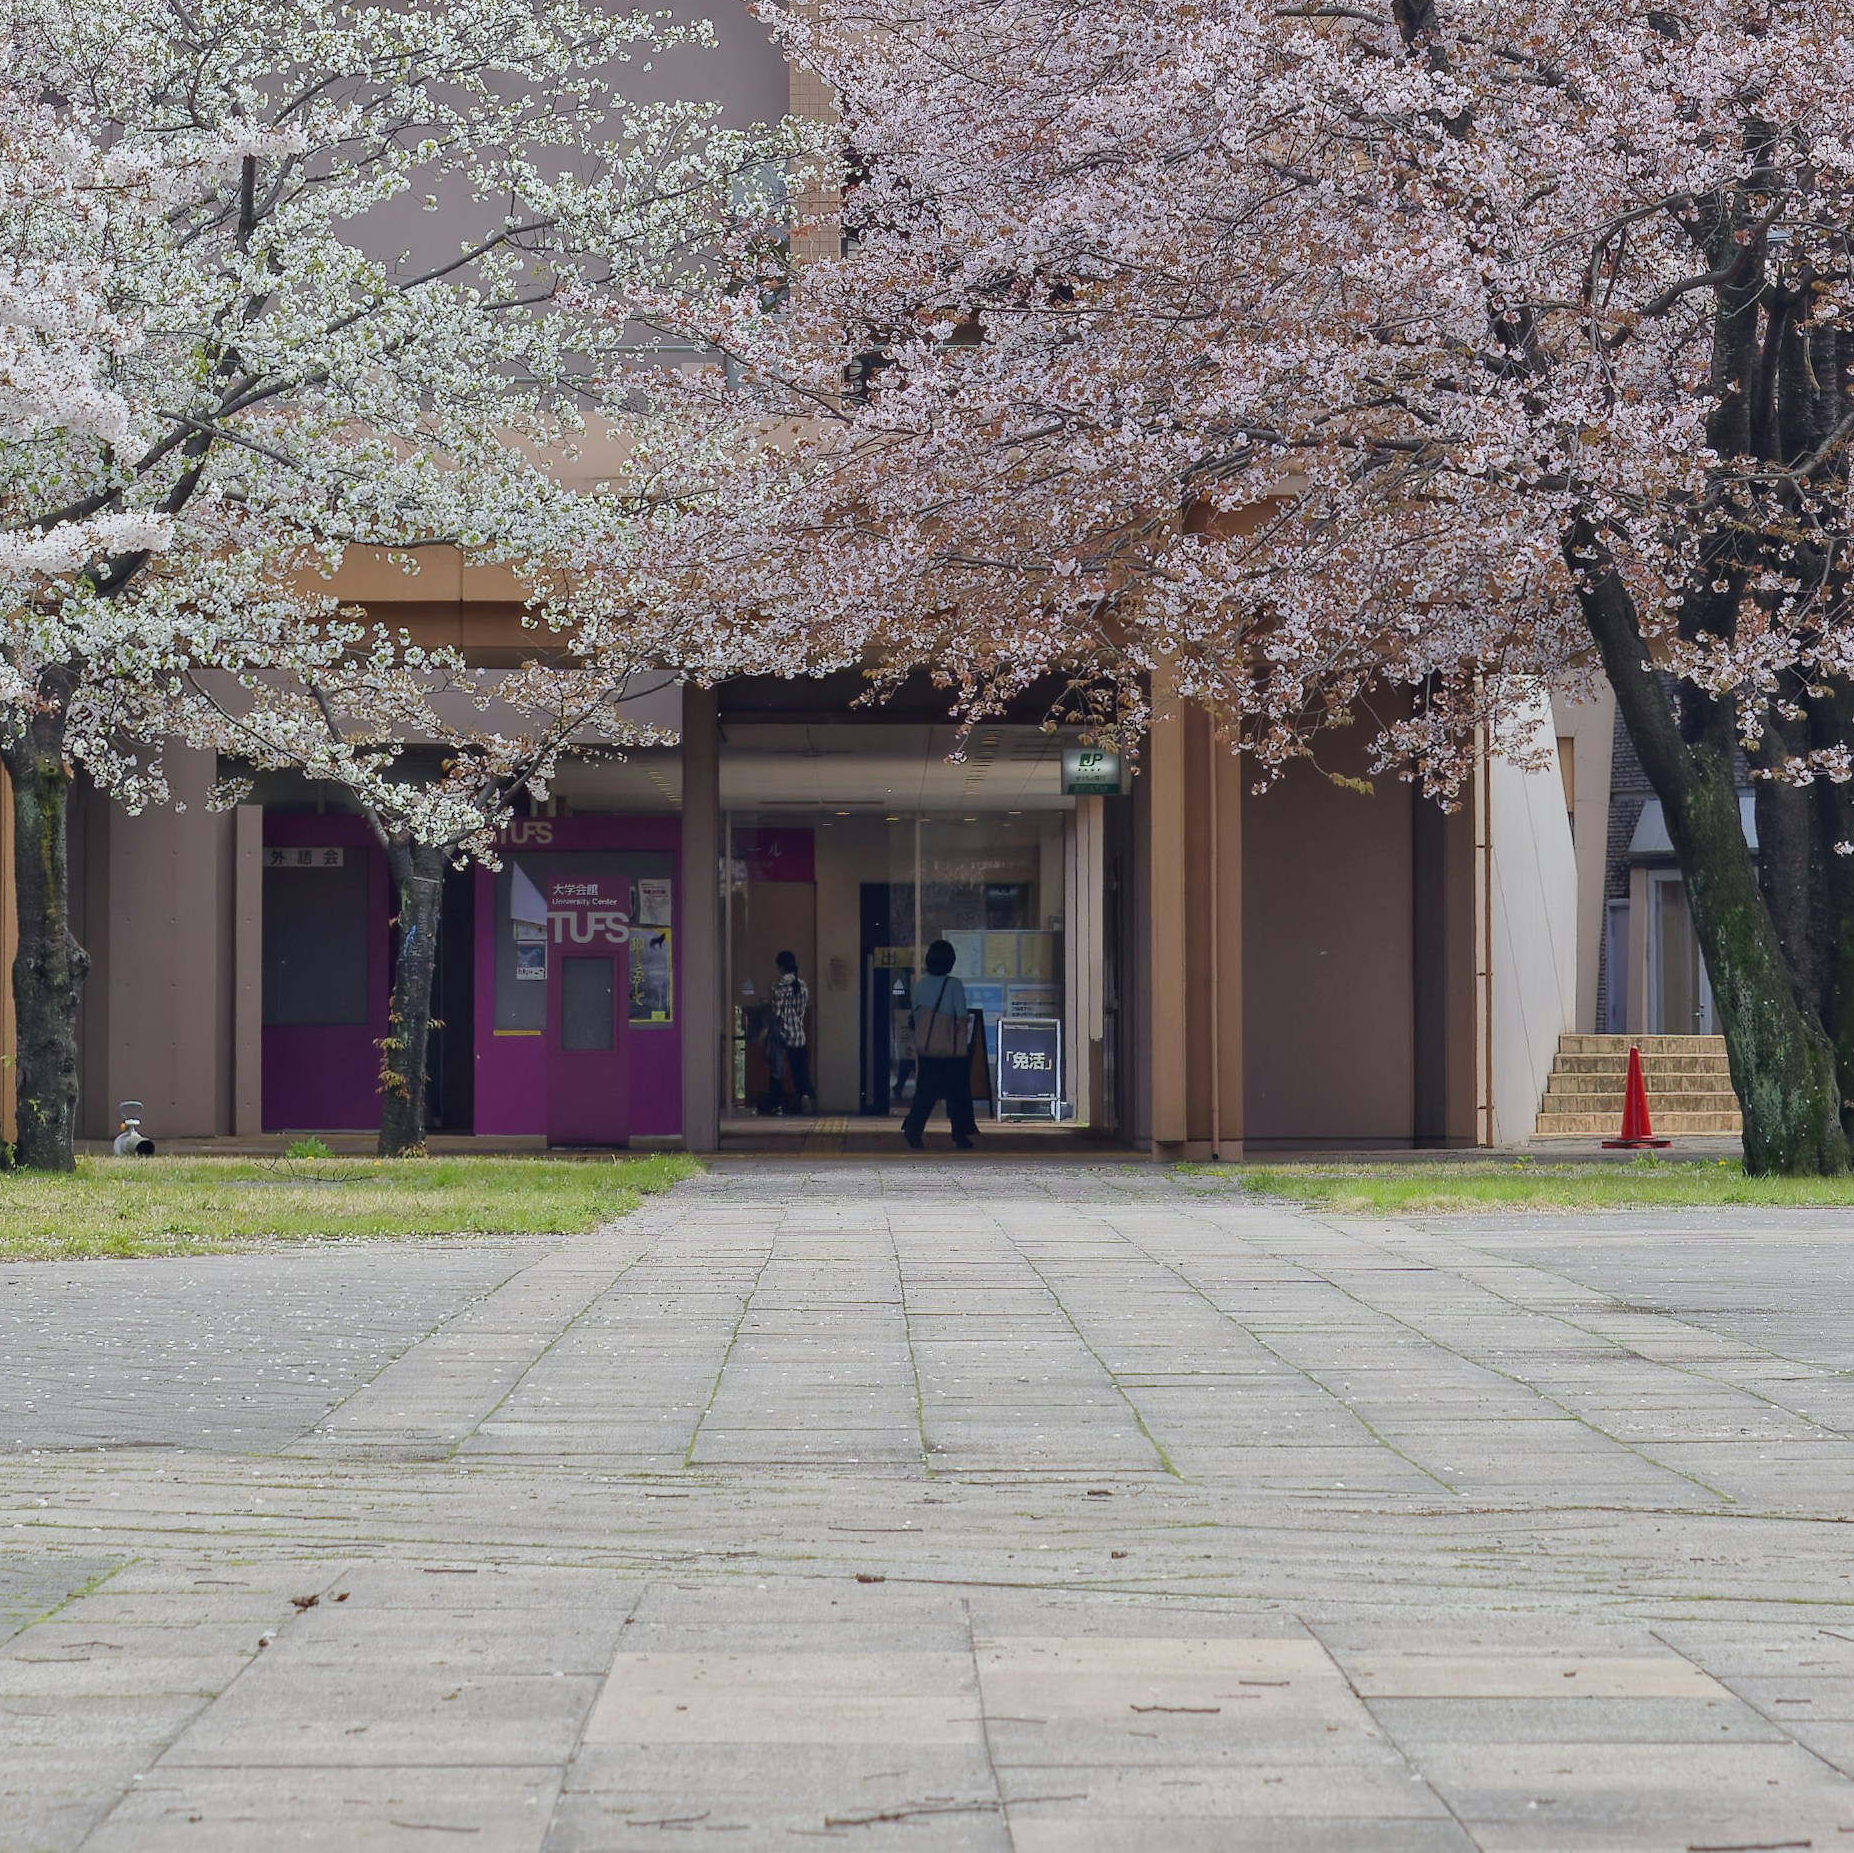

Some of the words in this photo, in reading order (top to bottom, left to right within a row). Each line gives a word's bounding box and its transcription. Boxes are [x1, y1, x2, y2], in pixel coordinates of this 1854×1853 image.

[270, 849, 339, 865] 外語会
[552, 883, 599, 896] 大学会館
[551, 898, 590, 907] University
[592, 898, 618, 906] Center
[547, 911, 630, 944] TUFS
[1006, 1051, 1052, 1071] 「免活」
